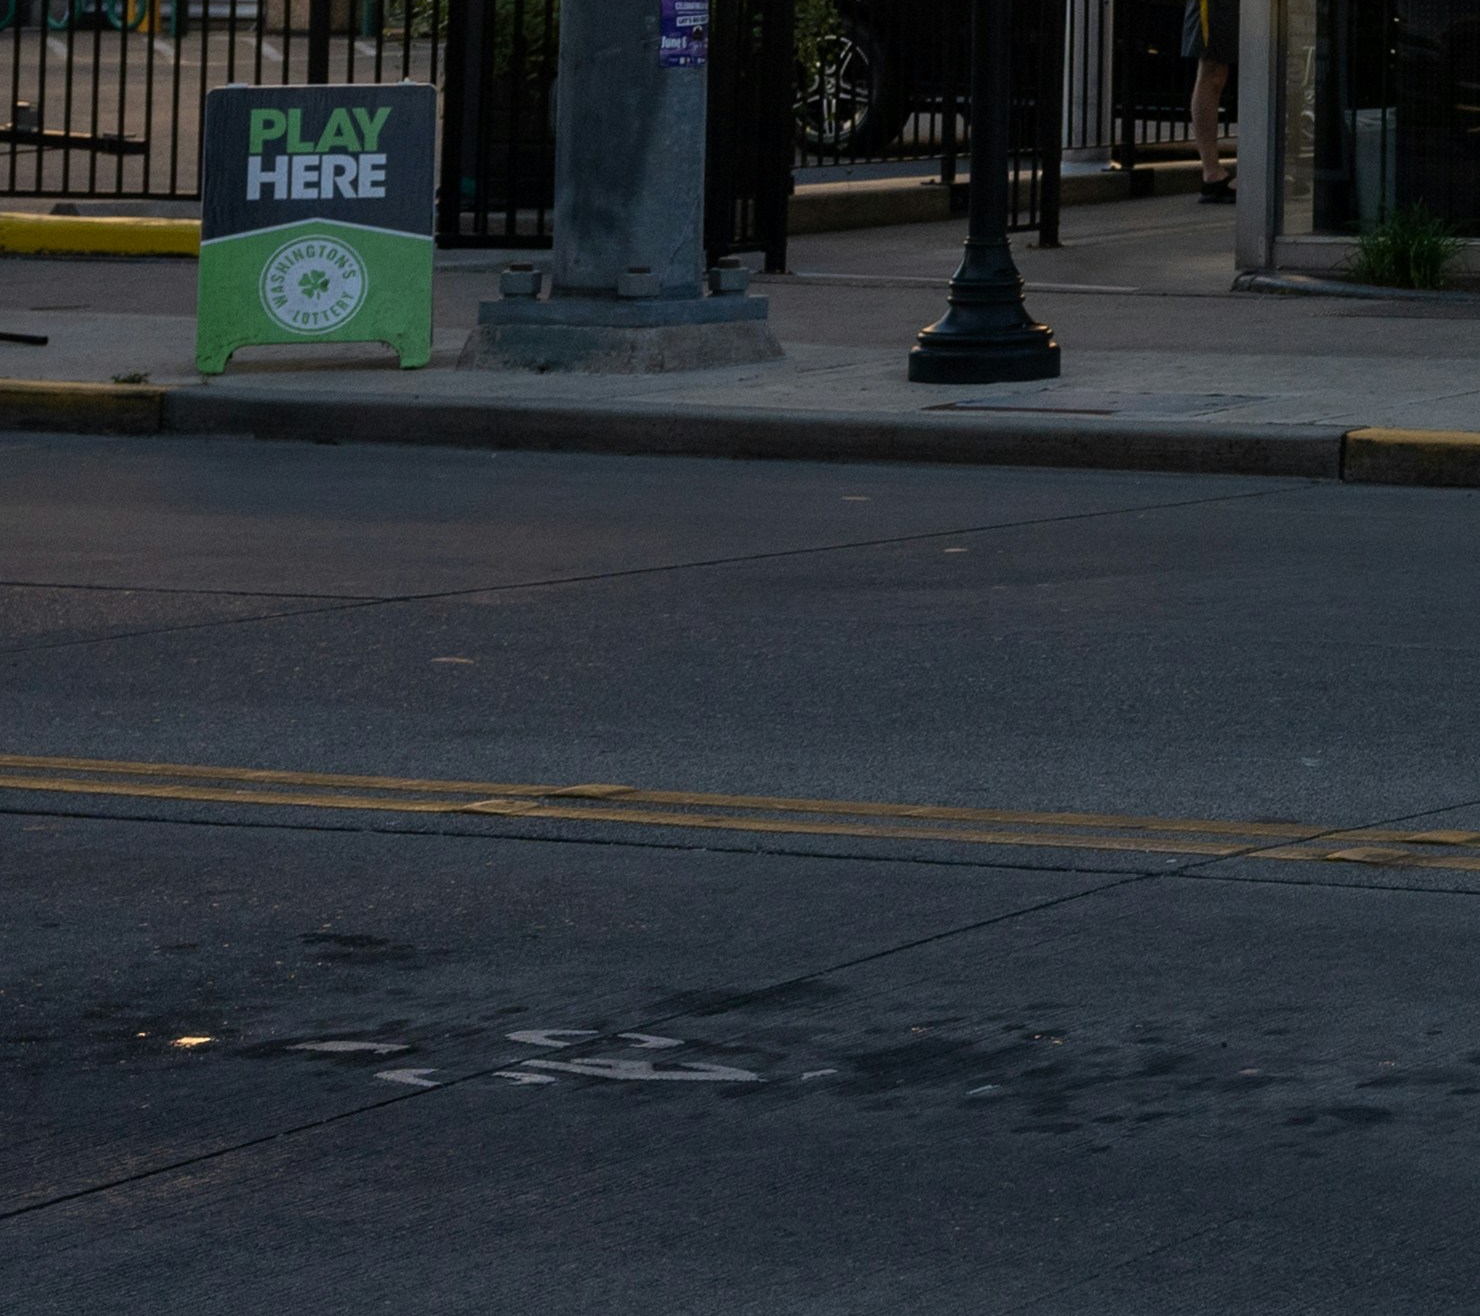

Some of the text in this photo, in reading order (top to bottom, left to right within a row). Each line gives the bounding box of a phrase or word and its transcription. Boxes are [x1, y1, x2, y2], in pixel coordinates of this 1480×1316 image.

[660, 35, 681, 49] June
[250, 106, 393, 154] PLAY
[246, 153, 388, 201] HERE
[270, 244, 358, 310] WASHINGTON'S
[291, 290, 355, 326] LOTTERY
